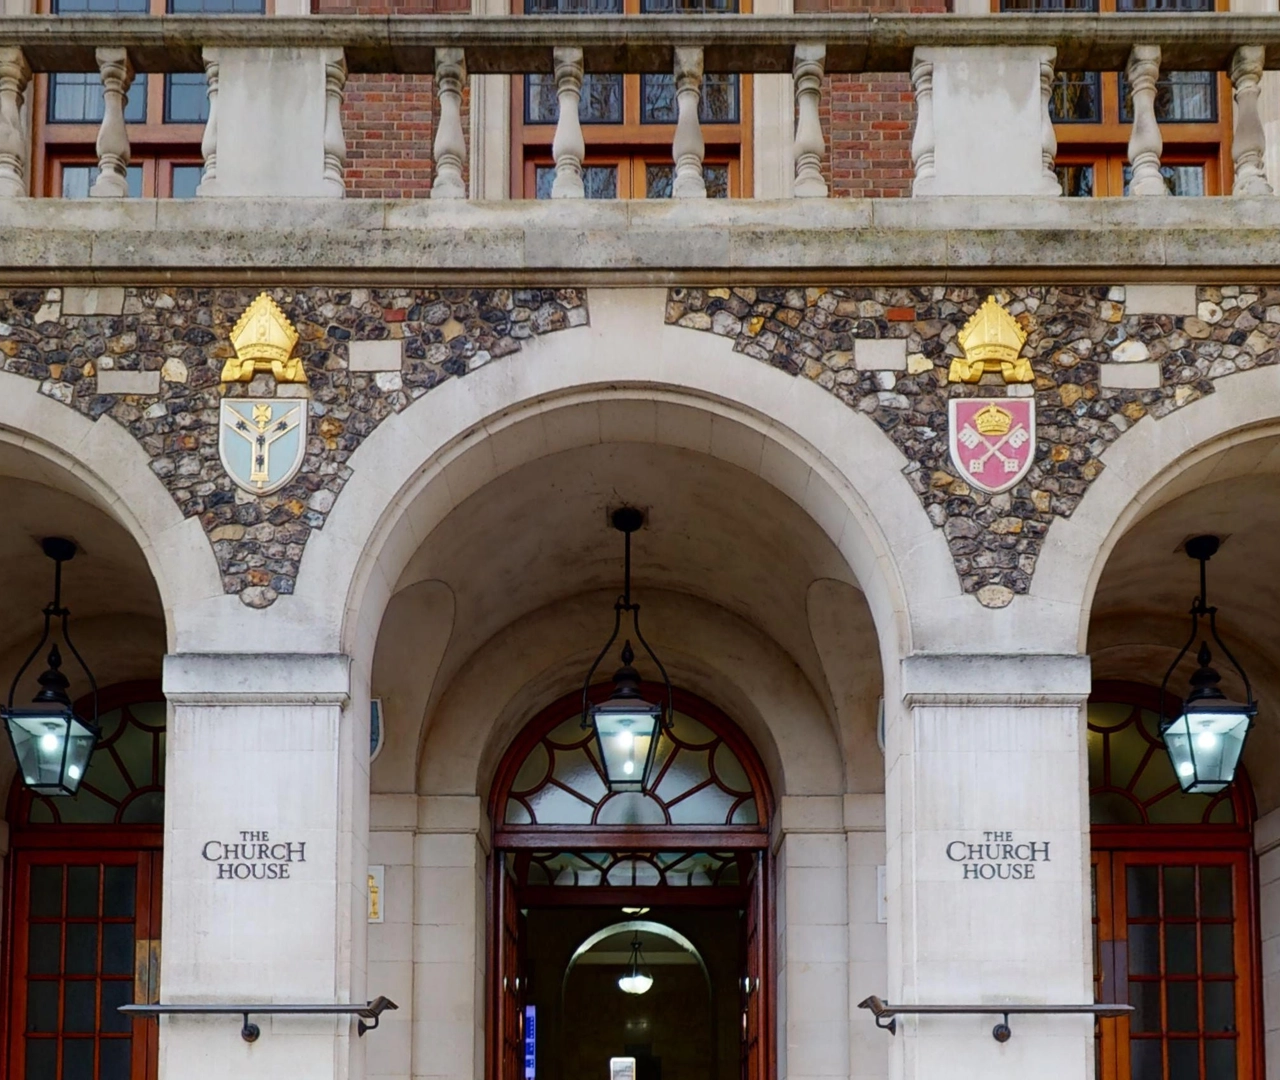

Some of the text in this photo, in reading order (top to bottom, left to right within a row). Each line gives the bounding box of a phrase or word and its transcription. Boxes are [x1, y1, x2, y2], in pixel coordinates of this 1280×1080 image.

[240, 831, 270, 841] THE
[983, 831, 1014, 841] THE
[202, 840, 307, 862] CHURCH
[946, 840, 1051, 862] CHURCH
[217, 863, 291, 880] HOUSE
[962, 863, 1036, 880] HOUSE
